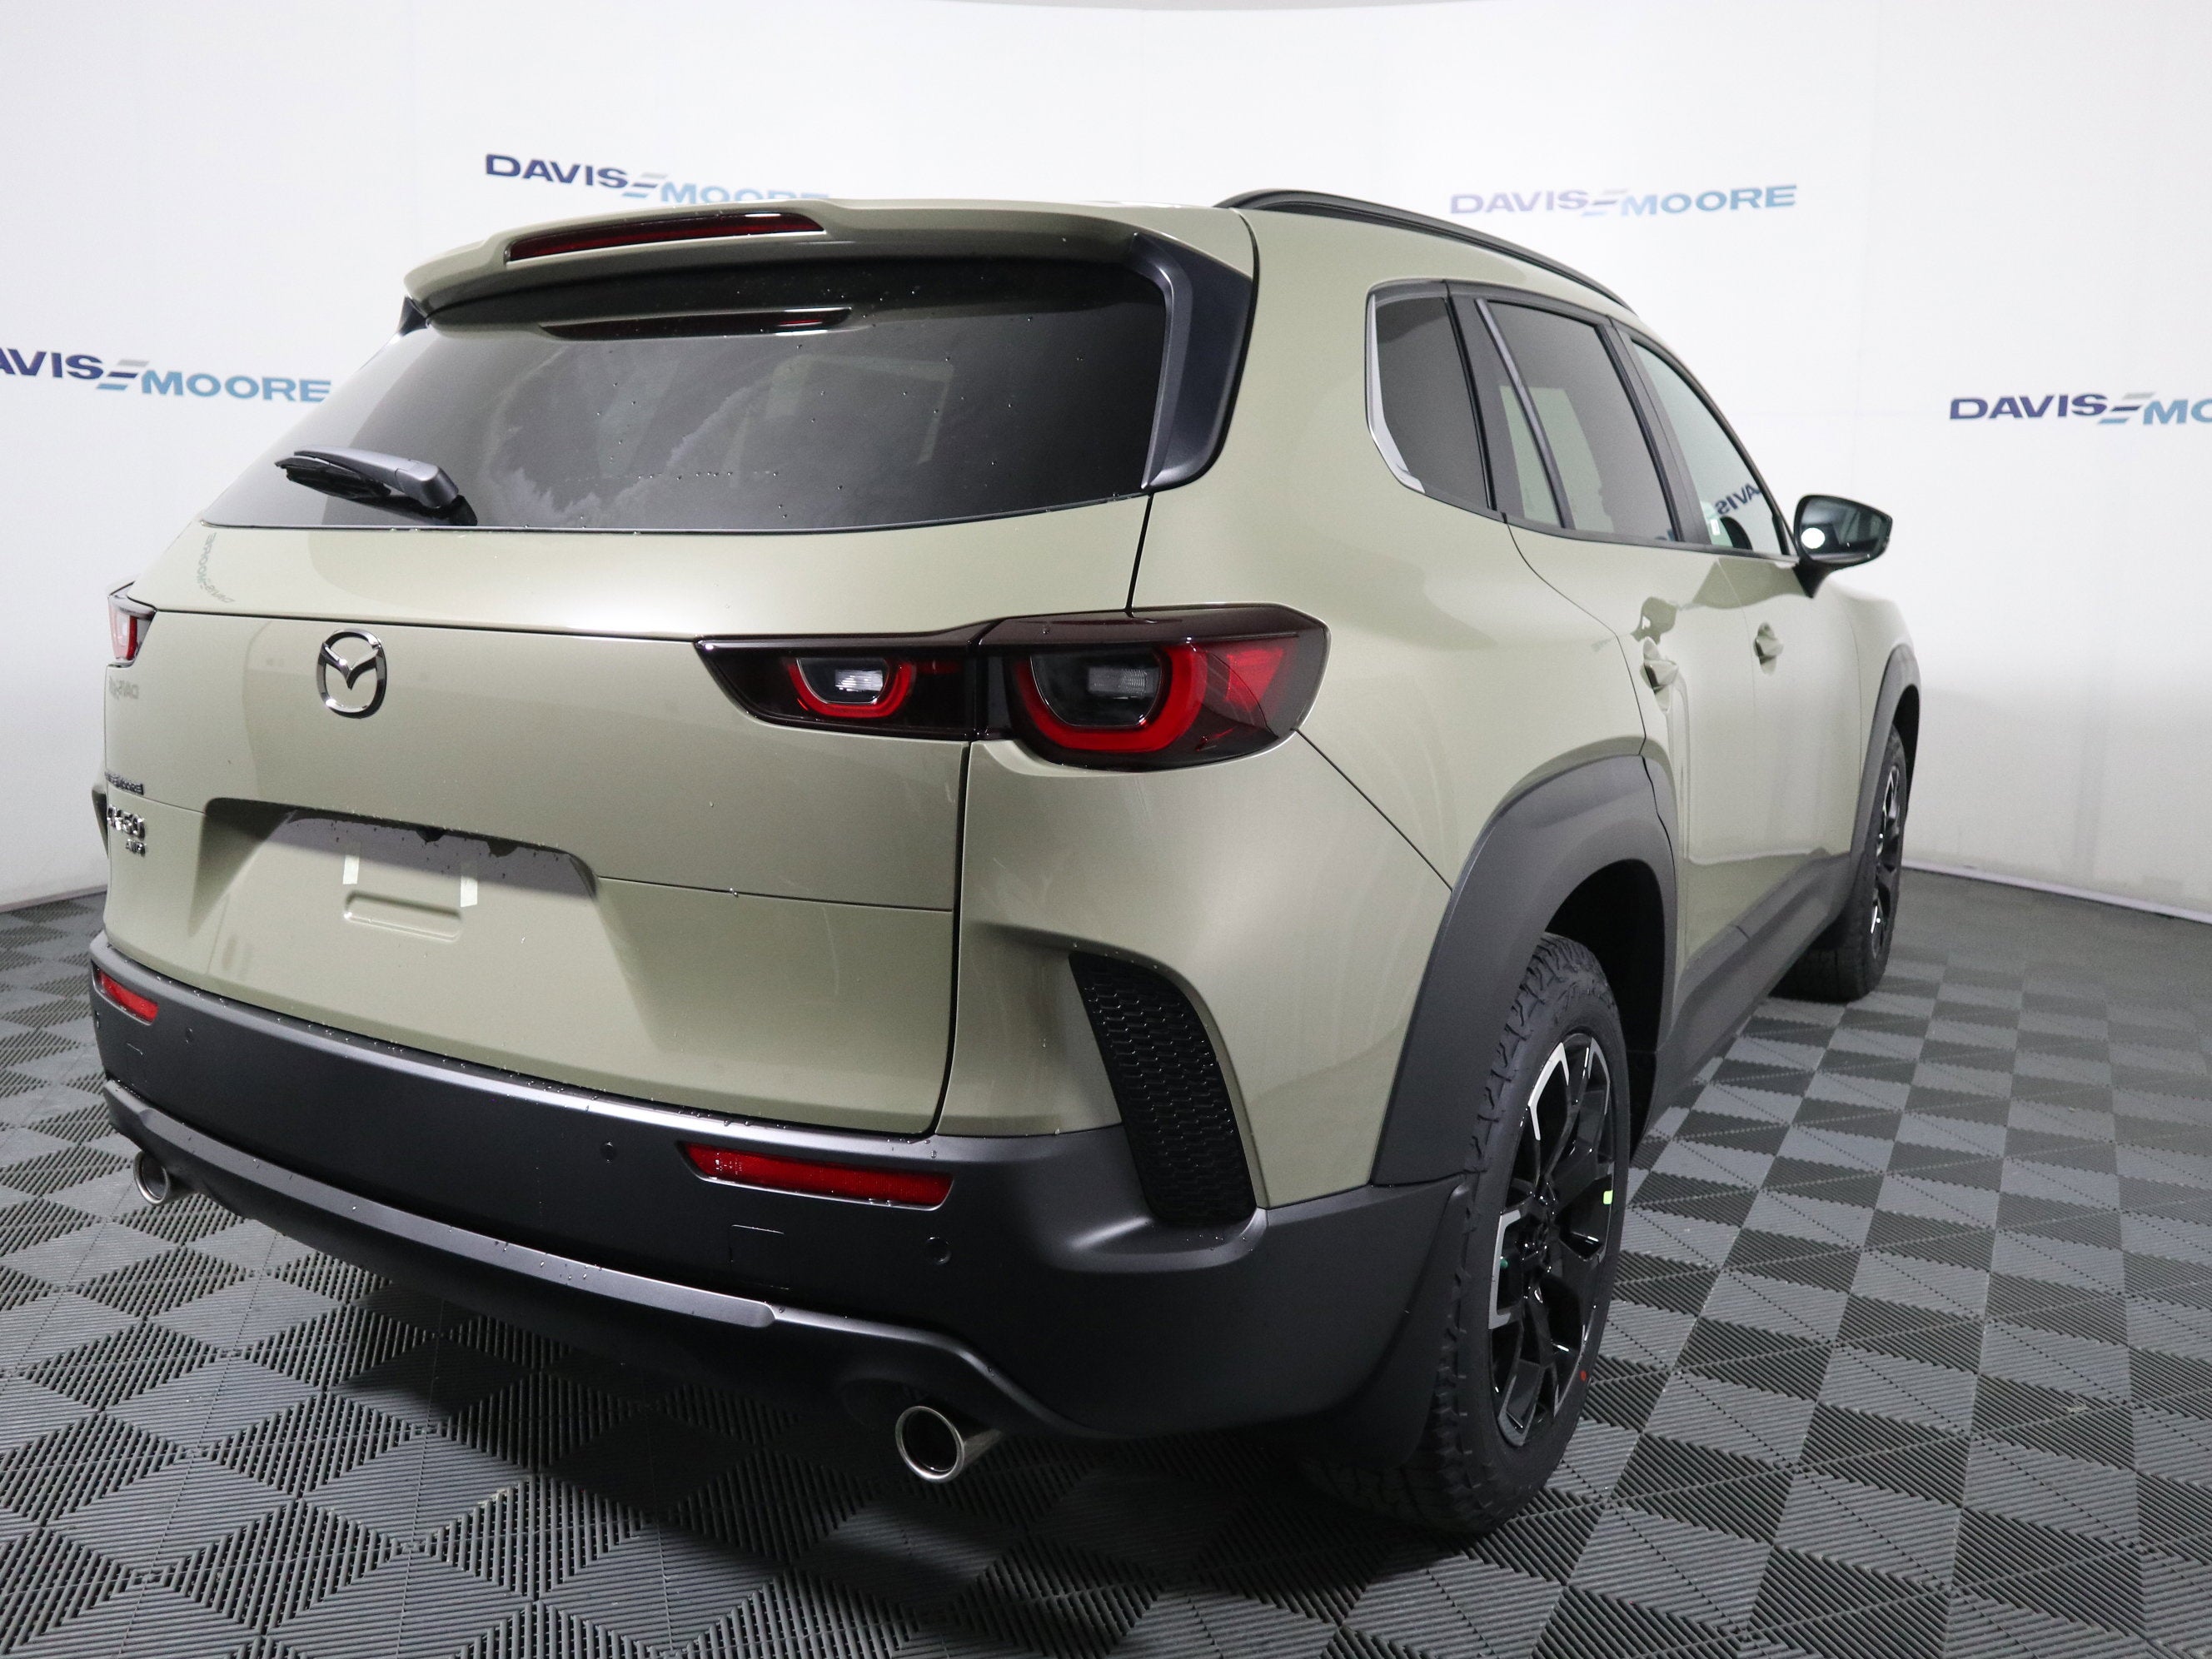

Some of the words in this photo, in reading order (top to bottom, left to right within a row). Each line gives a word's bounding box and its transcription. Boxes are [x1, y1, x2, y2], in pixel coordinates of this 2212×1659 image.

[486, 154, 628, 188] DAVIS
[660, 182, 829, 204] MOO
[1450, 189, 1588, 215] DAVIS
[1621, 184, 1797, 216] MOORE
[141, 370, 331, 402] MOORE
[1950, 393, 2108, 419] DAVIS
